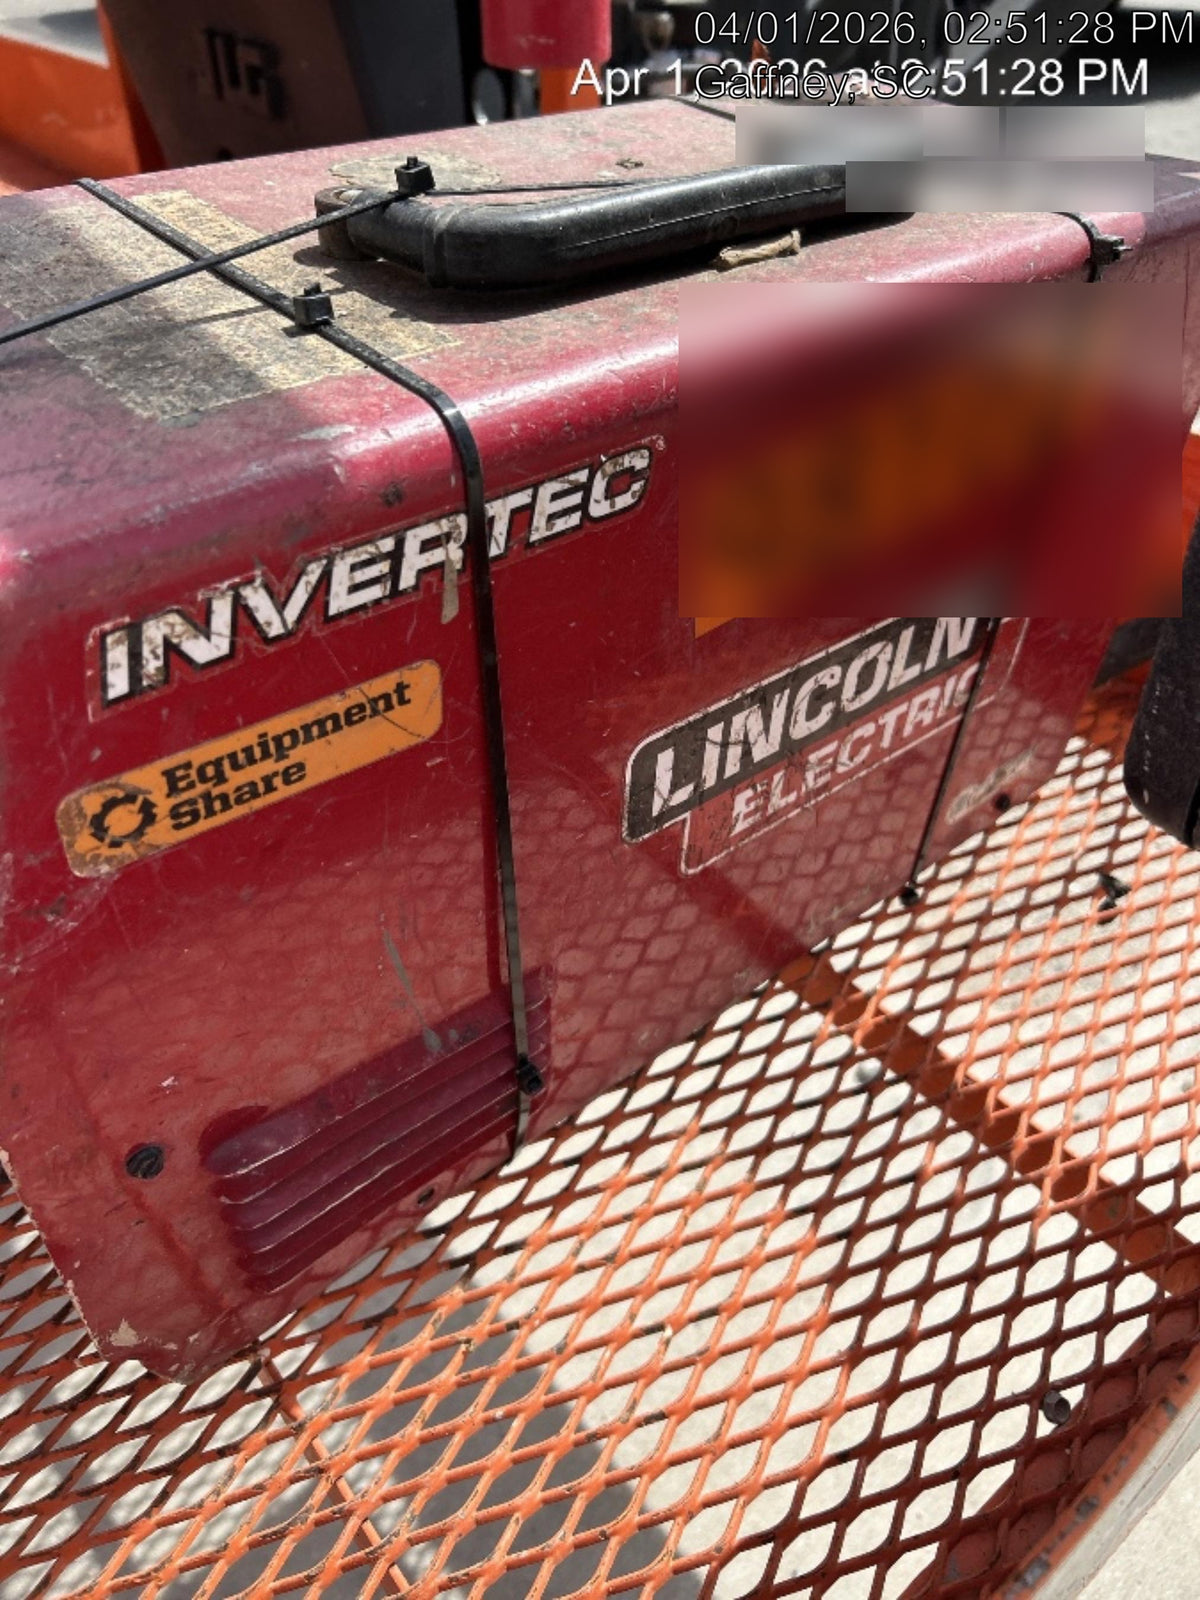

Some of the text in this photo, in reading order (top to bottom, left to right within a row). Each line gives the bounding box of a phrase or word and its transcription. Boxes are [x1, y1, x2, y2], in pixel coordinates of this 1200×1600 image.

[100, 444, 653, 705] INVERTEC
[162, 679, 412, 798] Equipment
[168, 761, 307, 832] Share
[651, 617, 977, 817] LINCOLN
